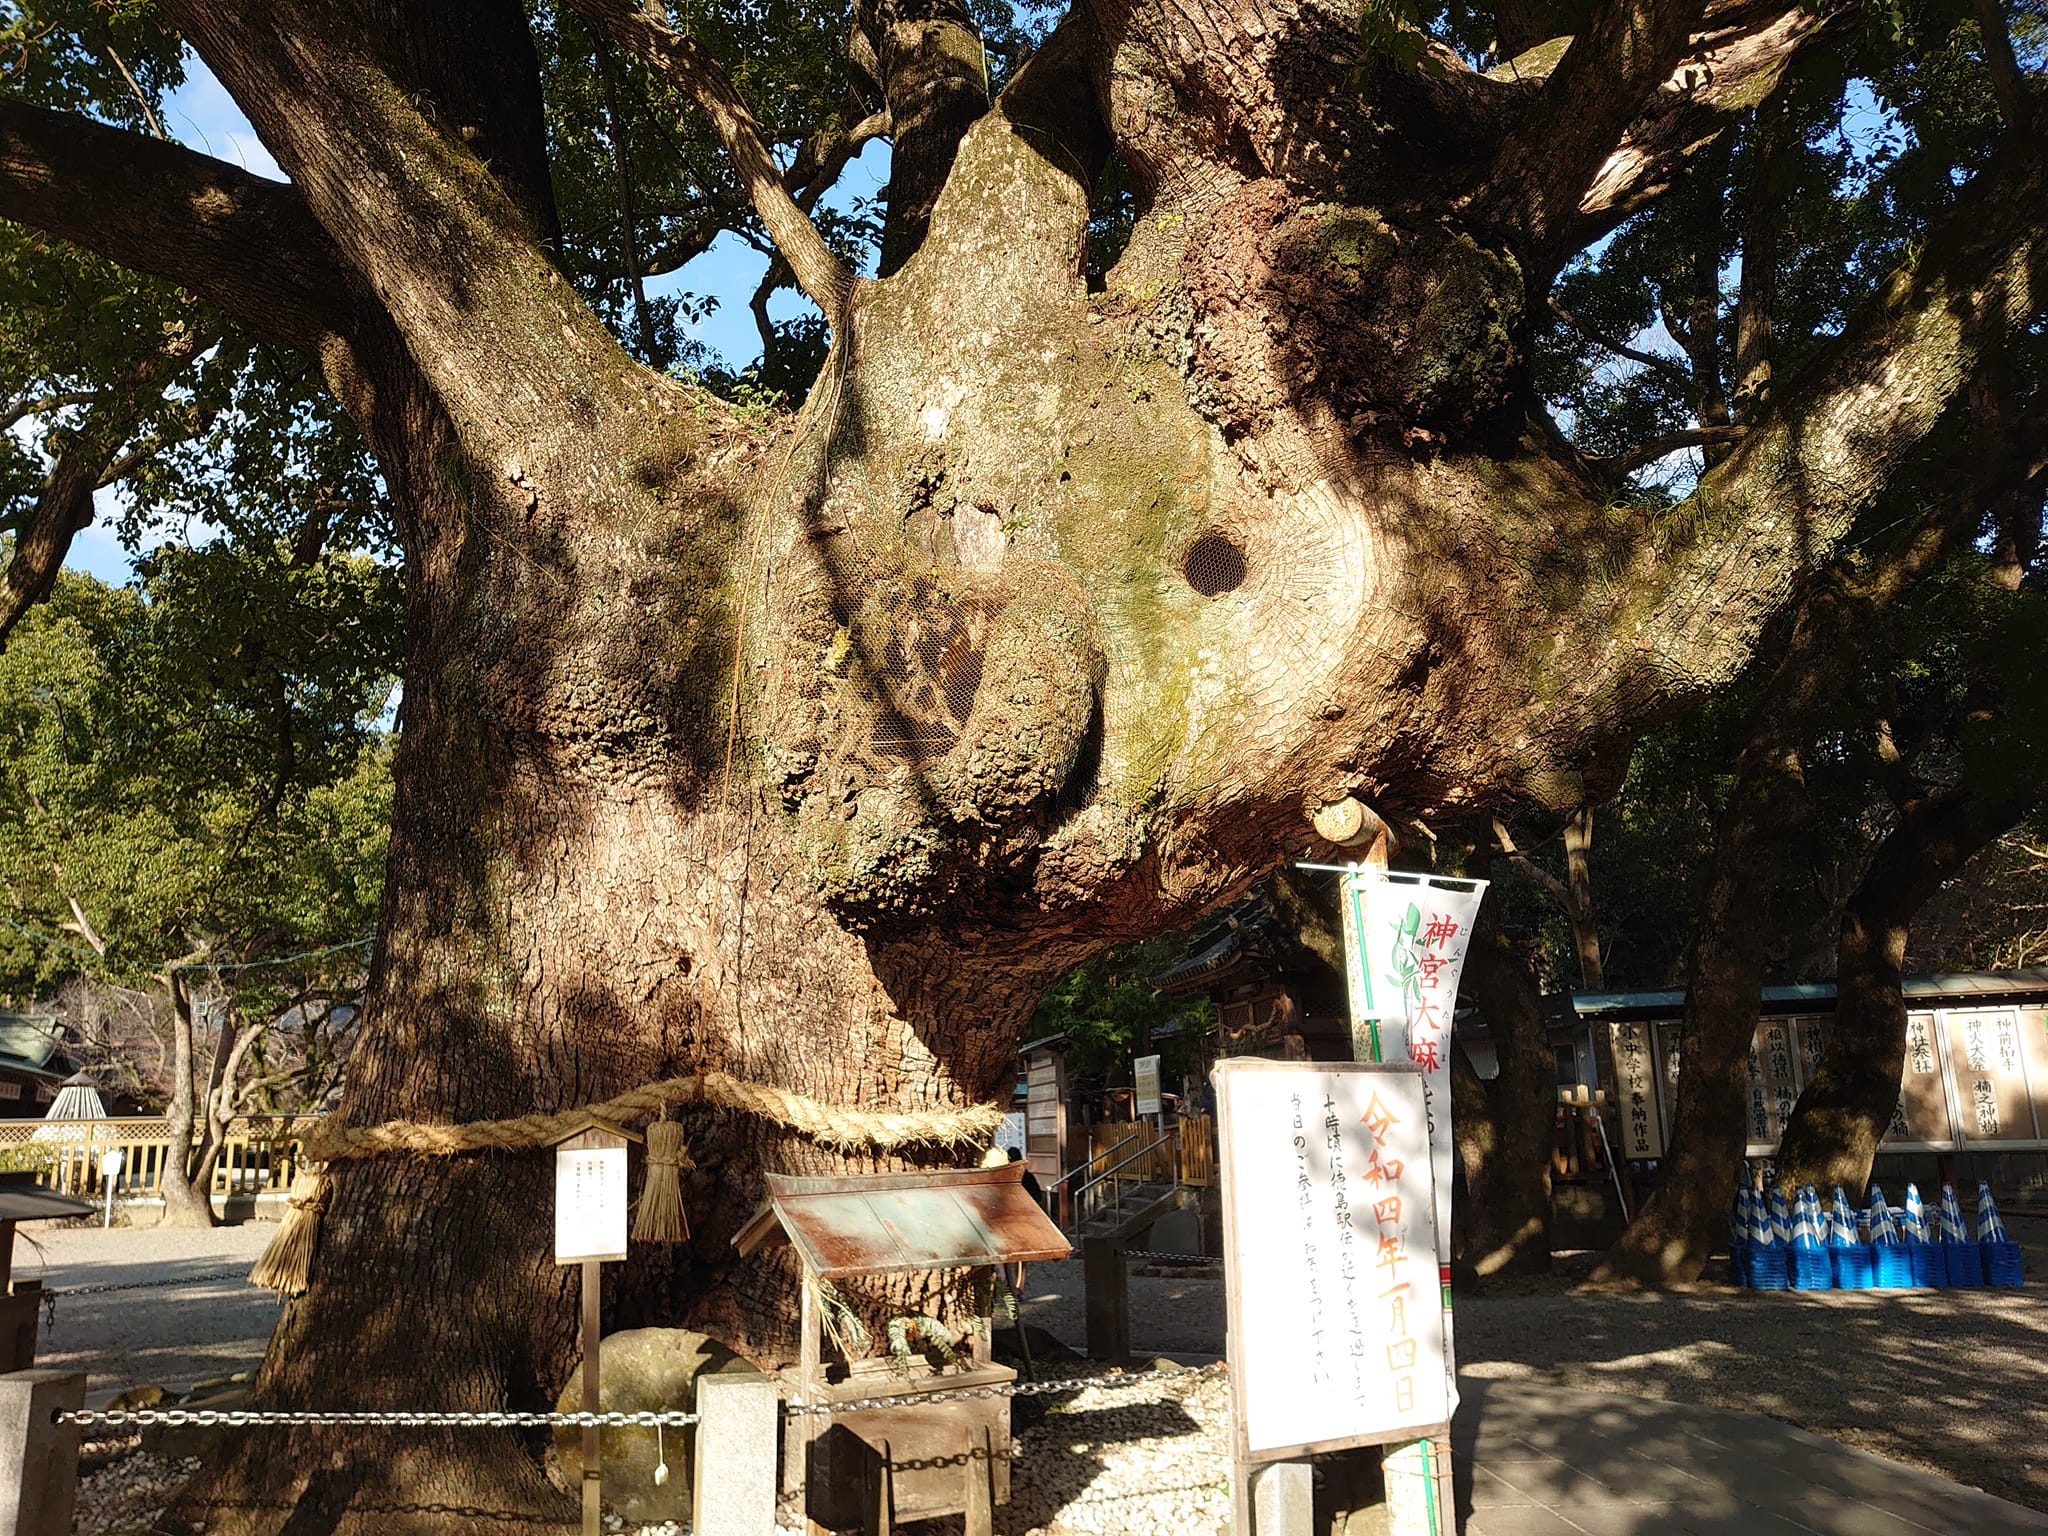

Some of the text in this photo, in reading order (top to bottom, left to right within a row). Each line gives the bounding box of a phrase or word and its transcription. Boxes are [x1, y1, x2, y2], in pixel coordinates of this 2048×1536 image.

[1412, 913, 1458, 1074] 神宮大麻
[1623, 1026, 1650, 1152] 小中学校奉納作品
[1967, 1019, 1986, 1071] 神火大祭
[1997, 1018, 2016, 1071] 神前拍手
[1974, 1079, 1998, 1134] 楠之神樹
[1360, 1091, 1416, 1413] 令和四年一月四日
